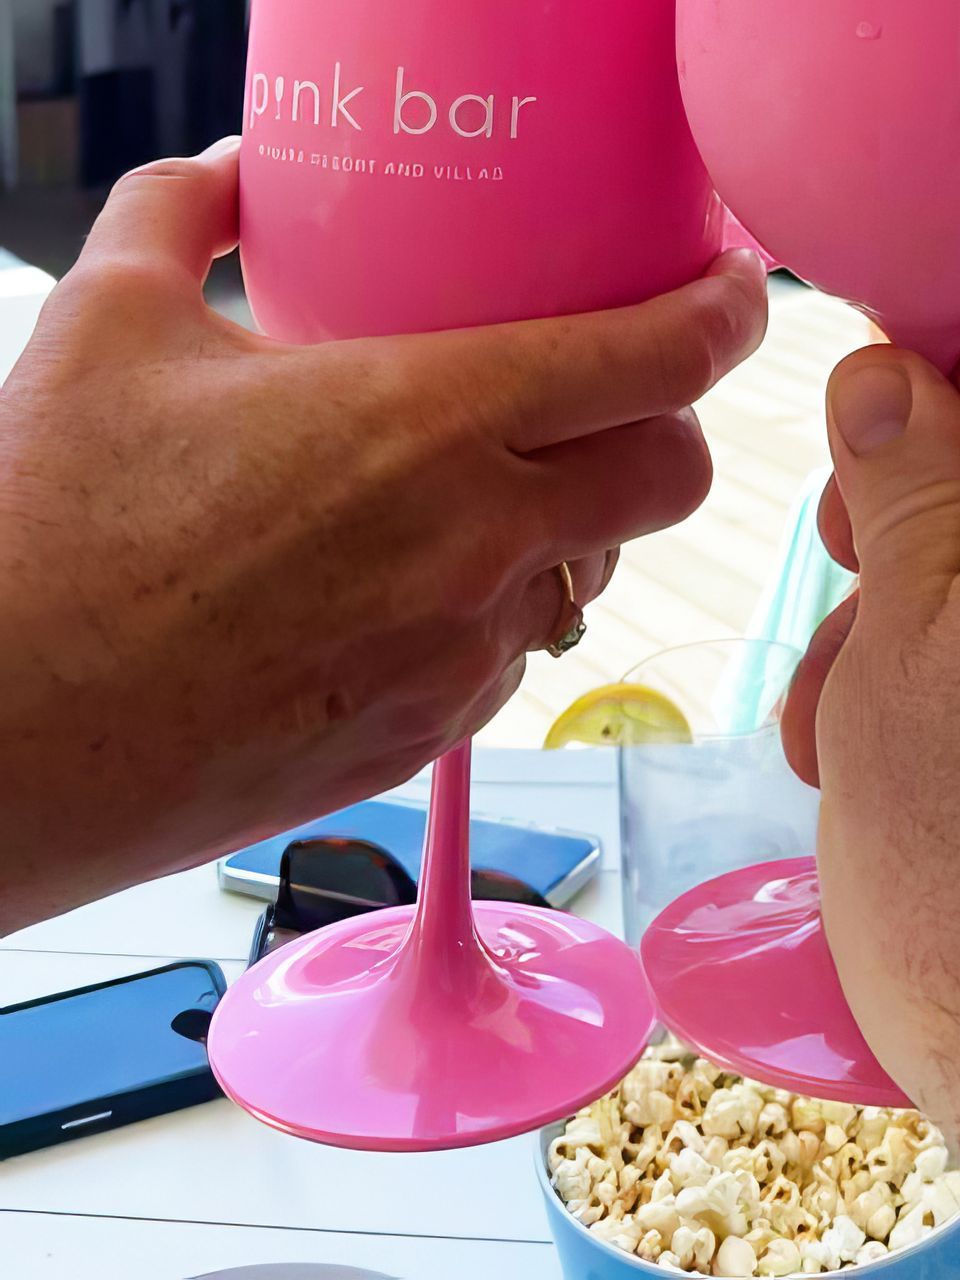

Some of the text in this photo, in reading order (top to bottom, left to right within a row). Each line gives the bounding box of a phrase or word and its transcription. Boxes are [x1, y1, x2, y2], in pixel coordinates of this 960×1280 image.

[248, 61, 537, 139] pink bar
[384, 161, 425, 178] AND
